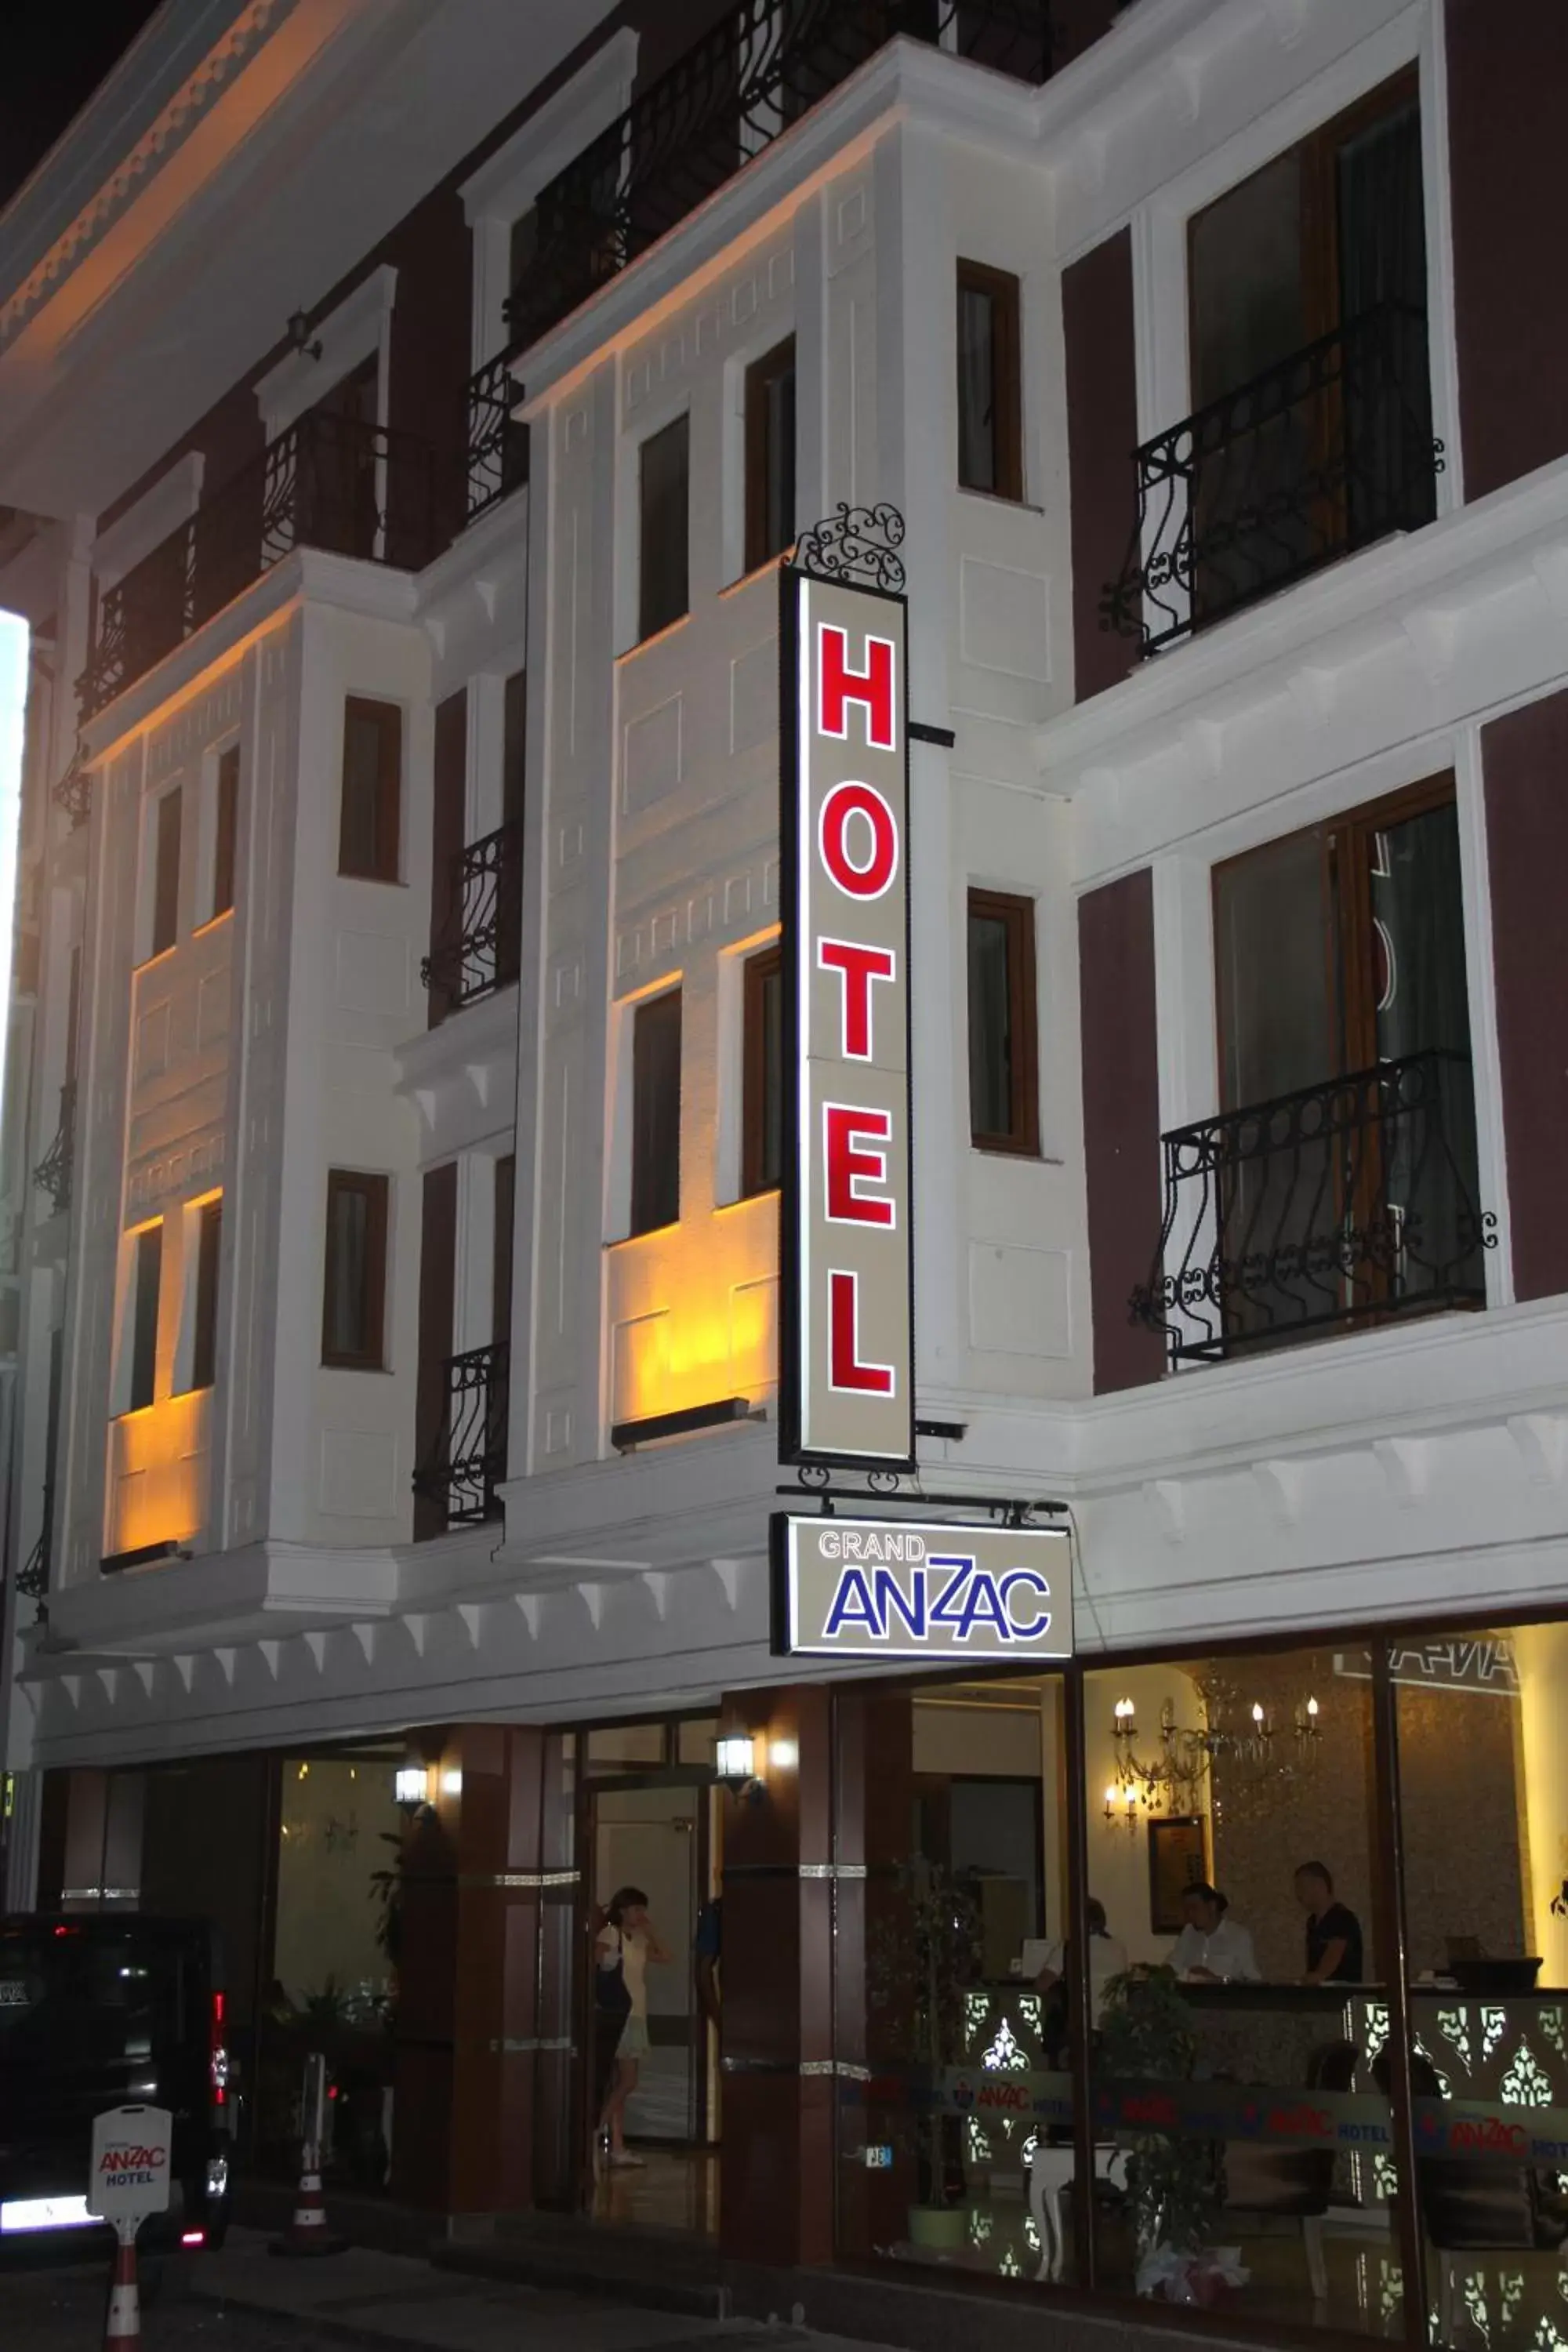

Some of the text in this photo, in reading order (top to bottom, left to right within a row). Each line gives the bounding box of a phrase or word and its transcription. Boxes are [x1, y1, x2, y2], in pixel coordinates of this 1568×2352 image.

[818, 622, 899, 1398] HOTEL
[818, 1531, 925, 1563] GRAND
[822, 1553, 1051, 1644] ANZAC
[978, 2082, 1029, 2111] ANZAC
[1338, 2123, 1389, 2143] HOTEL
[1450, 2117, 1526, 2158] ANZAC
[99, 2145, 165, 2172] ANZAC
[106, 2171, 155, 2187] HOTEL
